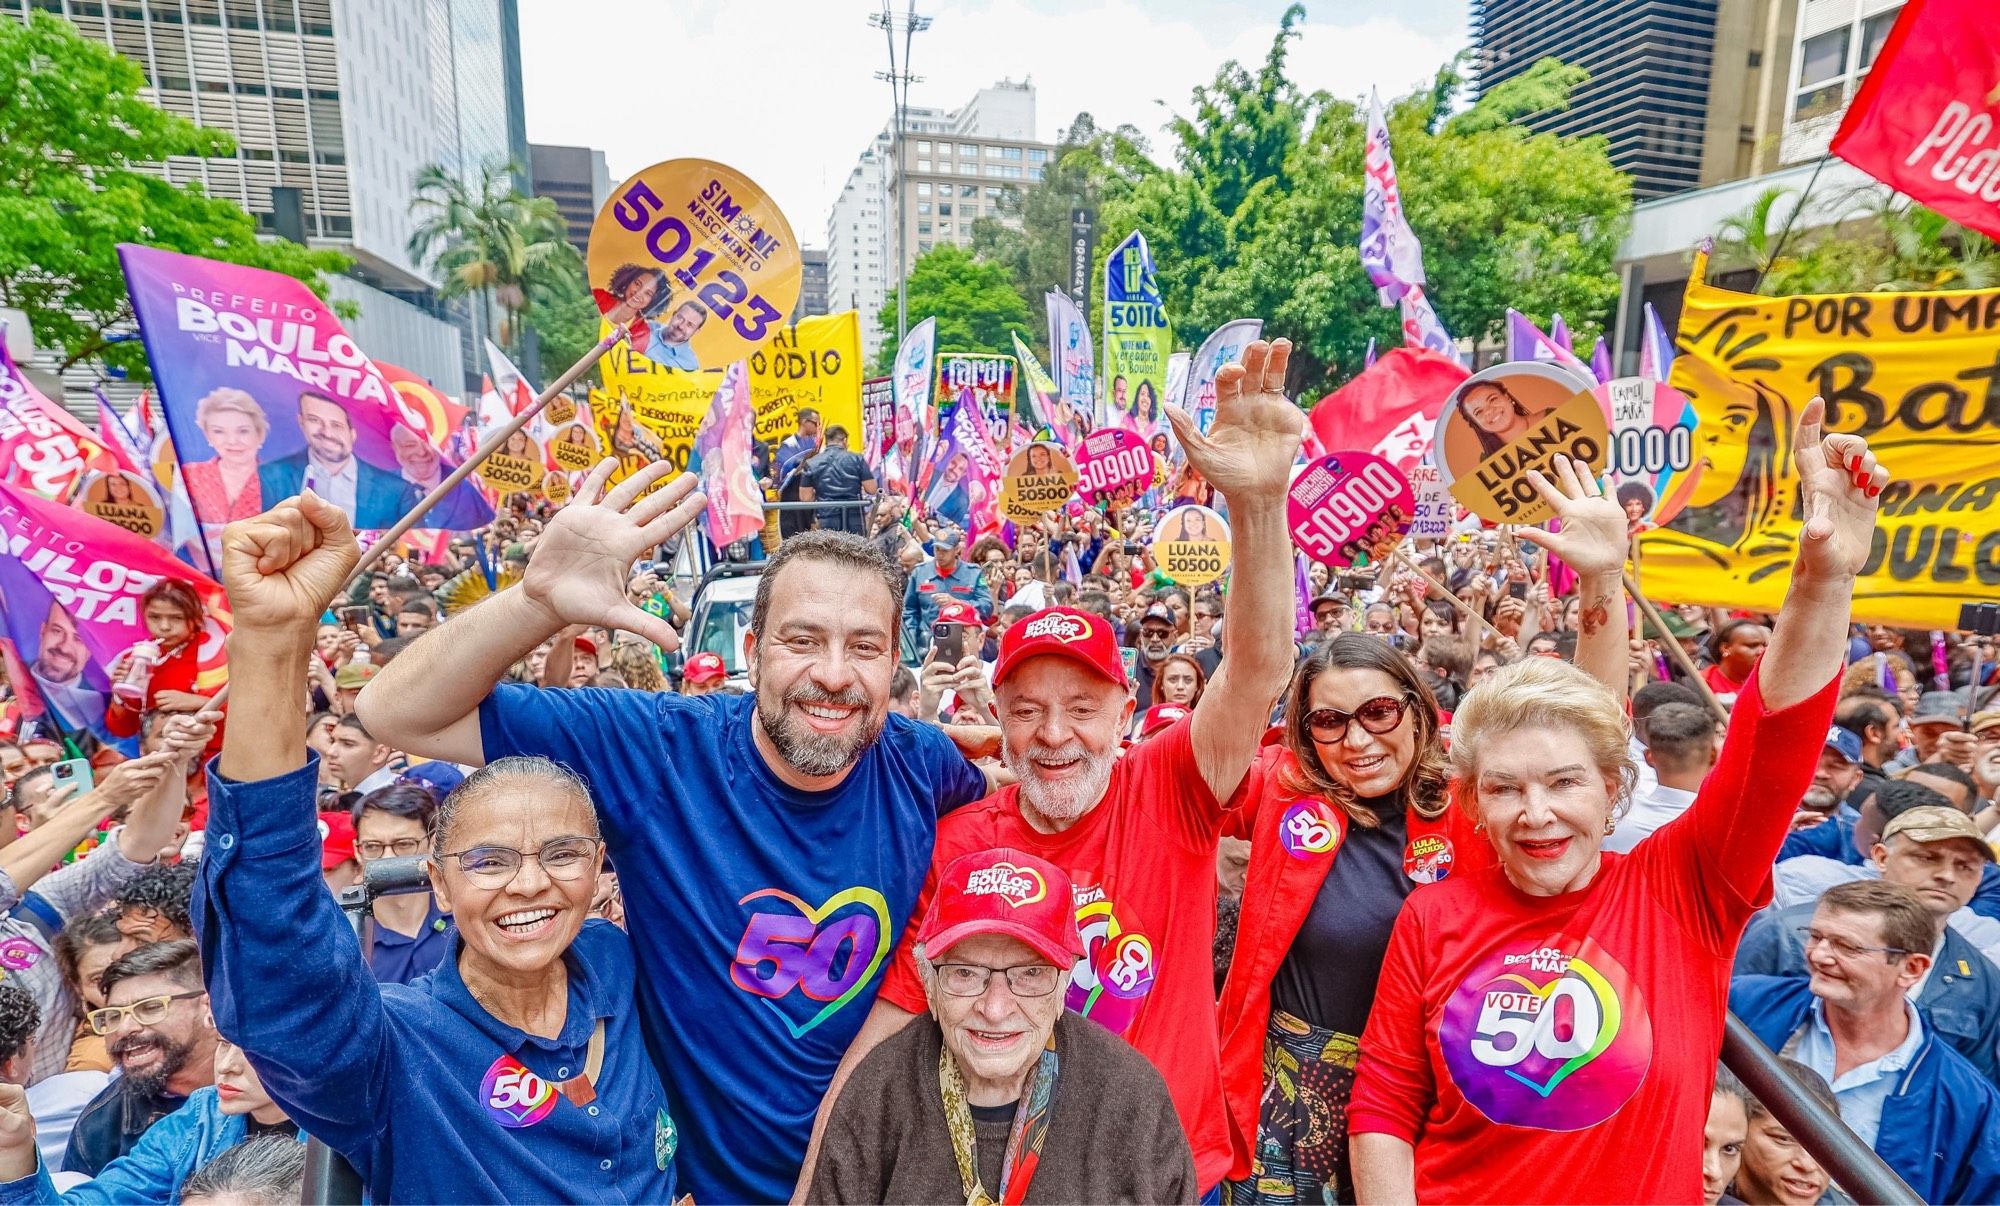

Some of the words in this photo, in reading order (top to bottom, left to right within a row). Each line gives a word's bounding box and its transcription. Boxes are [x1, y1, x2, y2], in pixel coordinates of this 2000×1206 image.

[701, 179, 781, 260] SIMONE
[687, 199, 762, 272] NASCIMENTO
[613, 180, 782, 342] 50123
[1072, 238, 1086, 297] Azevedo
[171, 282, 318, 322] PREFEITO
[1784, 296, 1873, 338] POR
[192, 332, 222, 345] VICE
[225, 338, 389, 406] MARTA
[752, 350, 767, 376] O
[556, 450, 590, 467] 50500
[558, 440, 590, 458] LUANA
[1475, 416, 1582, 491] LUANA
[487, 452, 532, 473] LUANA
[1077, 445, 1150, 494] 50900
[484, 464, 531, 485] 50500
[1016, 475, 1067, 488] LUANA
[1292, 465, 1328, 500] BANCADA
[1017, 487, 1069, 501] 50500
[1301, 474, 1337, 509] FEMINISTA
[1424, 491, 1441, 502] DE
[95, 503, 150, 521] LUANA
[1295, 461, 1403, 557] 50900
[1437, 503, 1447, 515] E
[1168, 543, 1220, 557] LUANA
[1167, 558, 1221, 572] 50500
[1026, 618, 1080, 633] BOULOS
[1032, 627, 1076, 638] MARTA
[1288, 811, 1331, 849] 50
[1412, 838, 1436, 850] LULA
[1413, 843, 1445, 857] BOULOS
[1437, 854, 1451, 864] 50
[967, 873, 1033, 891] BOULOS
[969, 868, 1012, 877] PREFEITO
[976, 884, 1027, 899] MARTA
[730, 912, 877, 1001] 50
[1108, 940, 1149, 992] 50
[1486, 992, 1540, 1013] VOTE
[1470, 977, 1600, 1067] 50
[489, 1073, 547, 1109] 50
